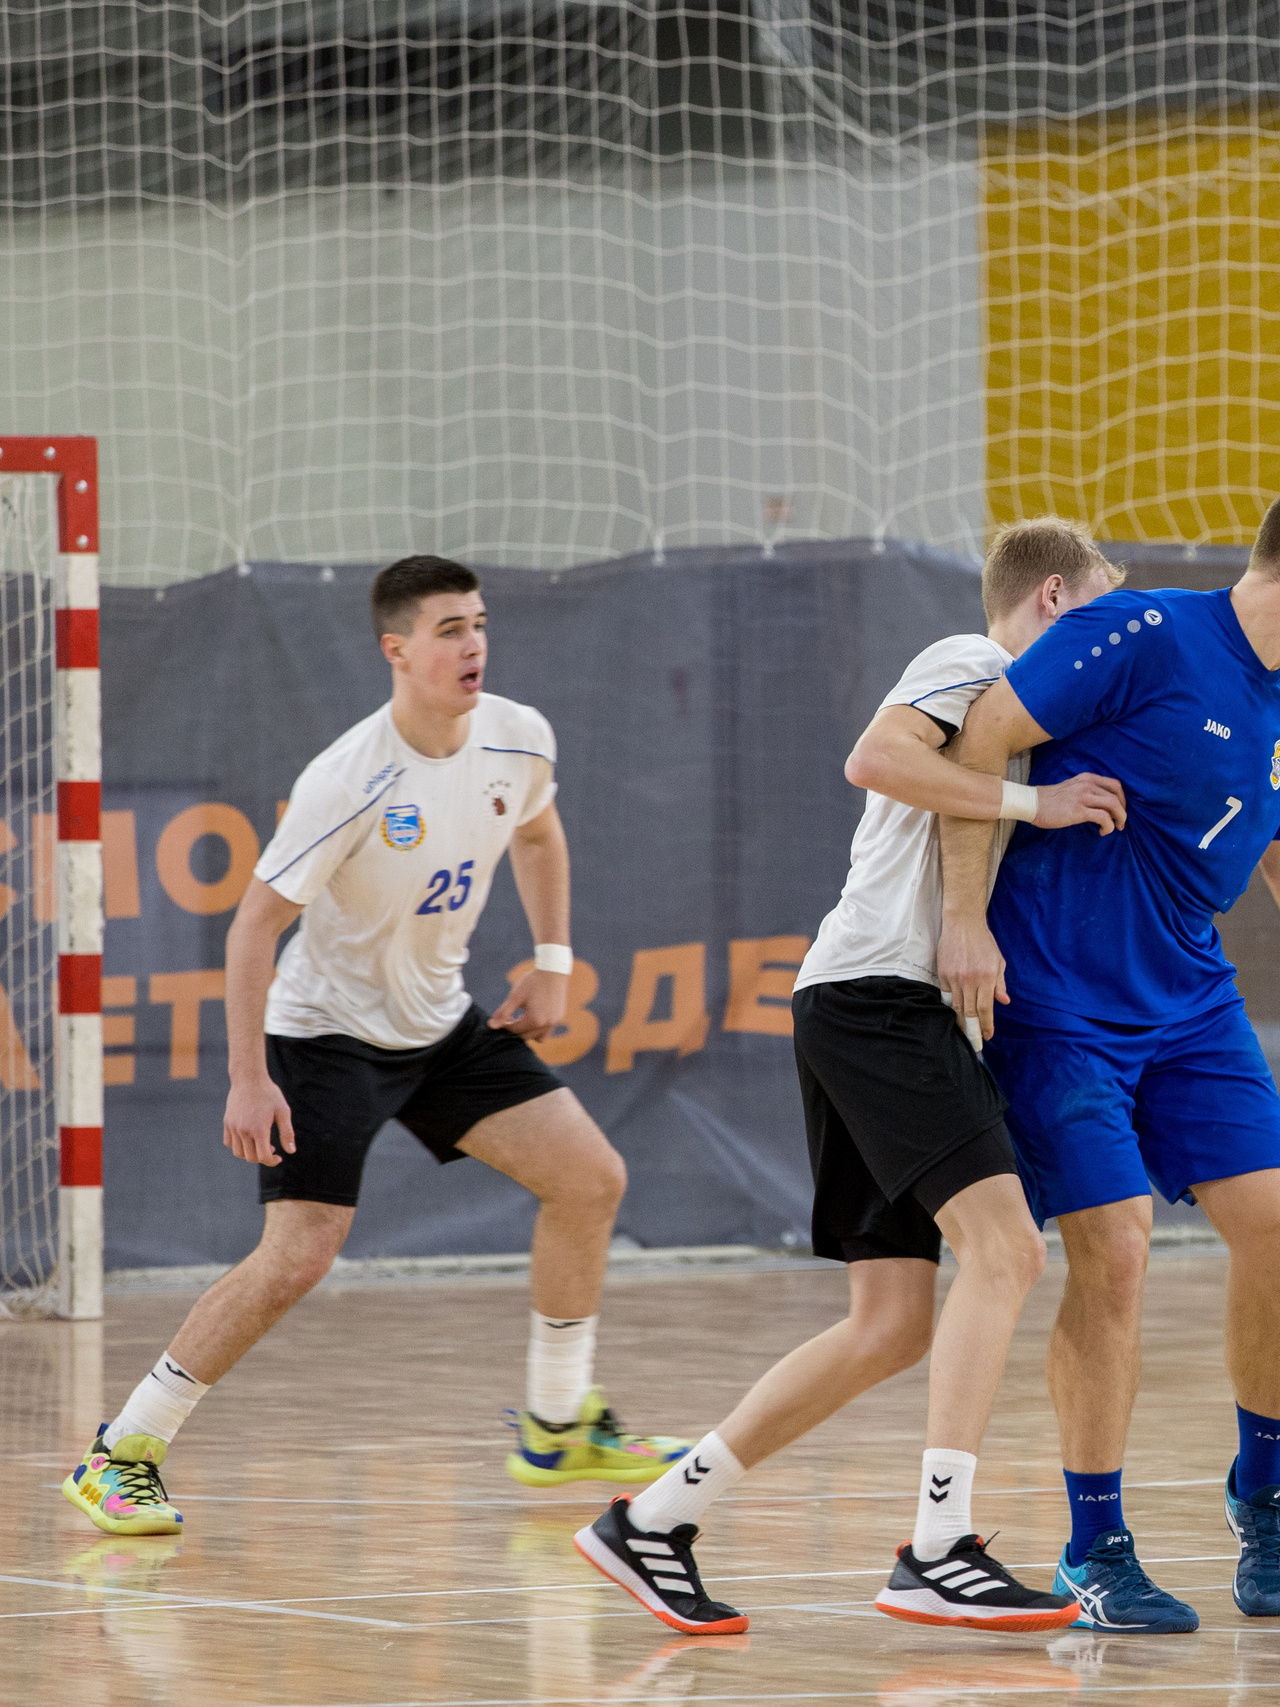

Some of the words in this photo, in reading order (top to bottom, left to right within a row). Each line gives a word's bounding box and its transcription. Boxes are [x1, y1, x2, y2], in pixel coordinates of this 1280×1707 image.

[1203, 718, 1231, 740] JAKO
[1198, 796, 1243, 850] 7
[414, 860, 475, 916] 25
[1077, 1492, 1119, 1502] JAKO
